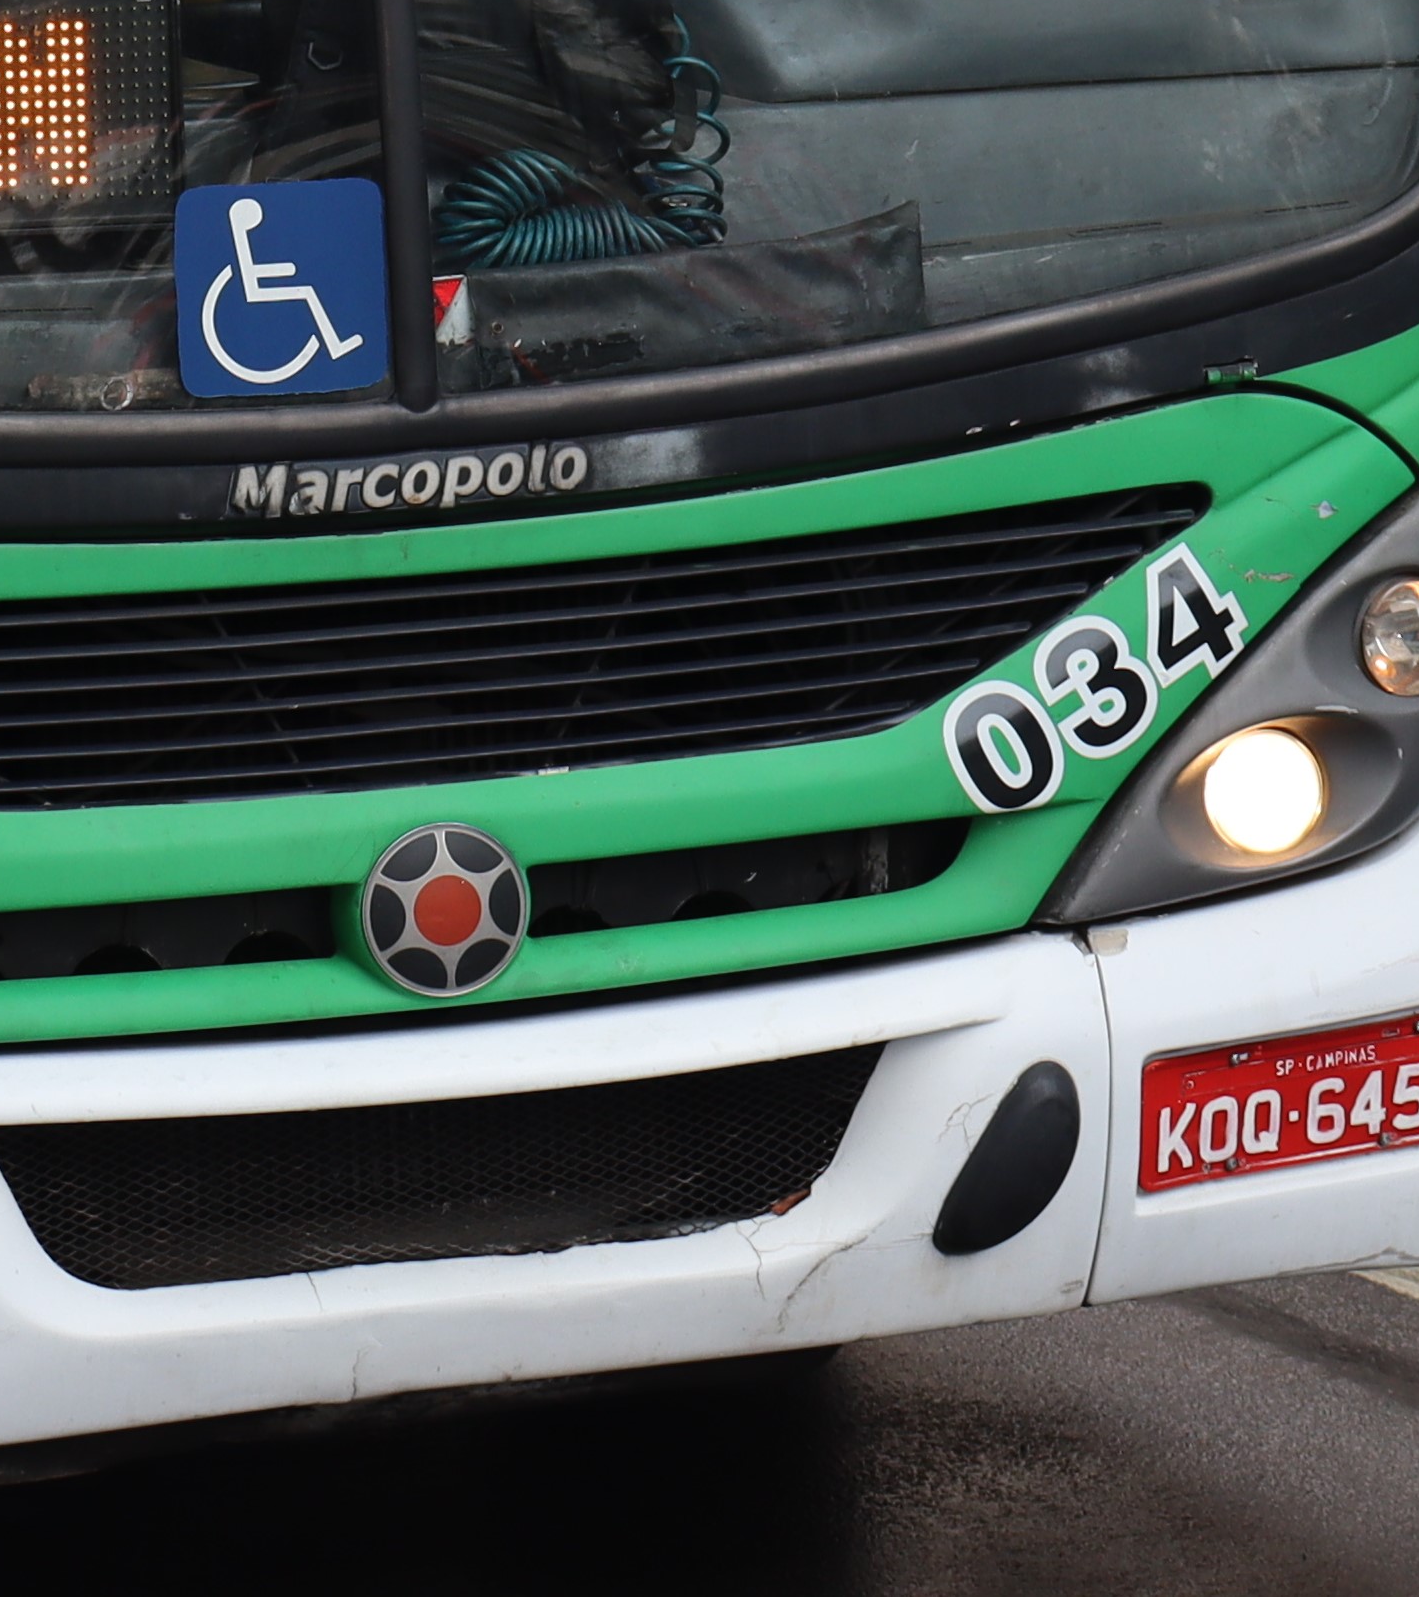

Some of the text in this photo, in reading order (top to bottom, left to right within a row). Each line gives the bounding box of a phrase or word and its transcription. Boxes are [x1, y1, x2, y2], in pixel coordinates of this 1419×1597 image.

[231, 443, 589, 519] Marcopolo
[944, 543, 1248, 813] 034
[1275, 1045, 1376, 1076] SP CAMPINAS
